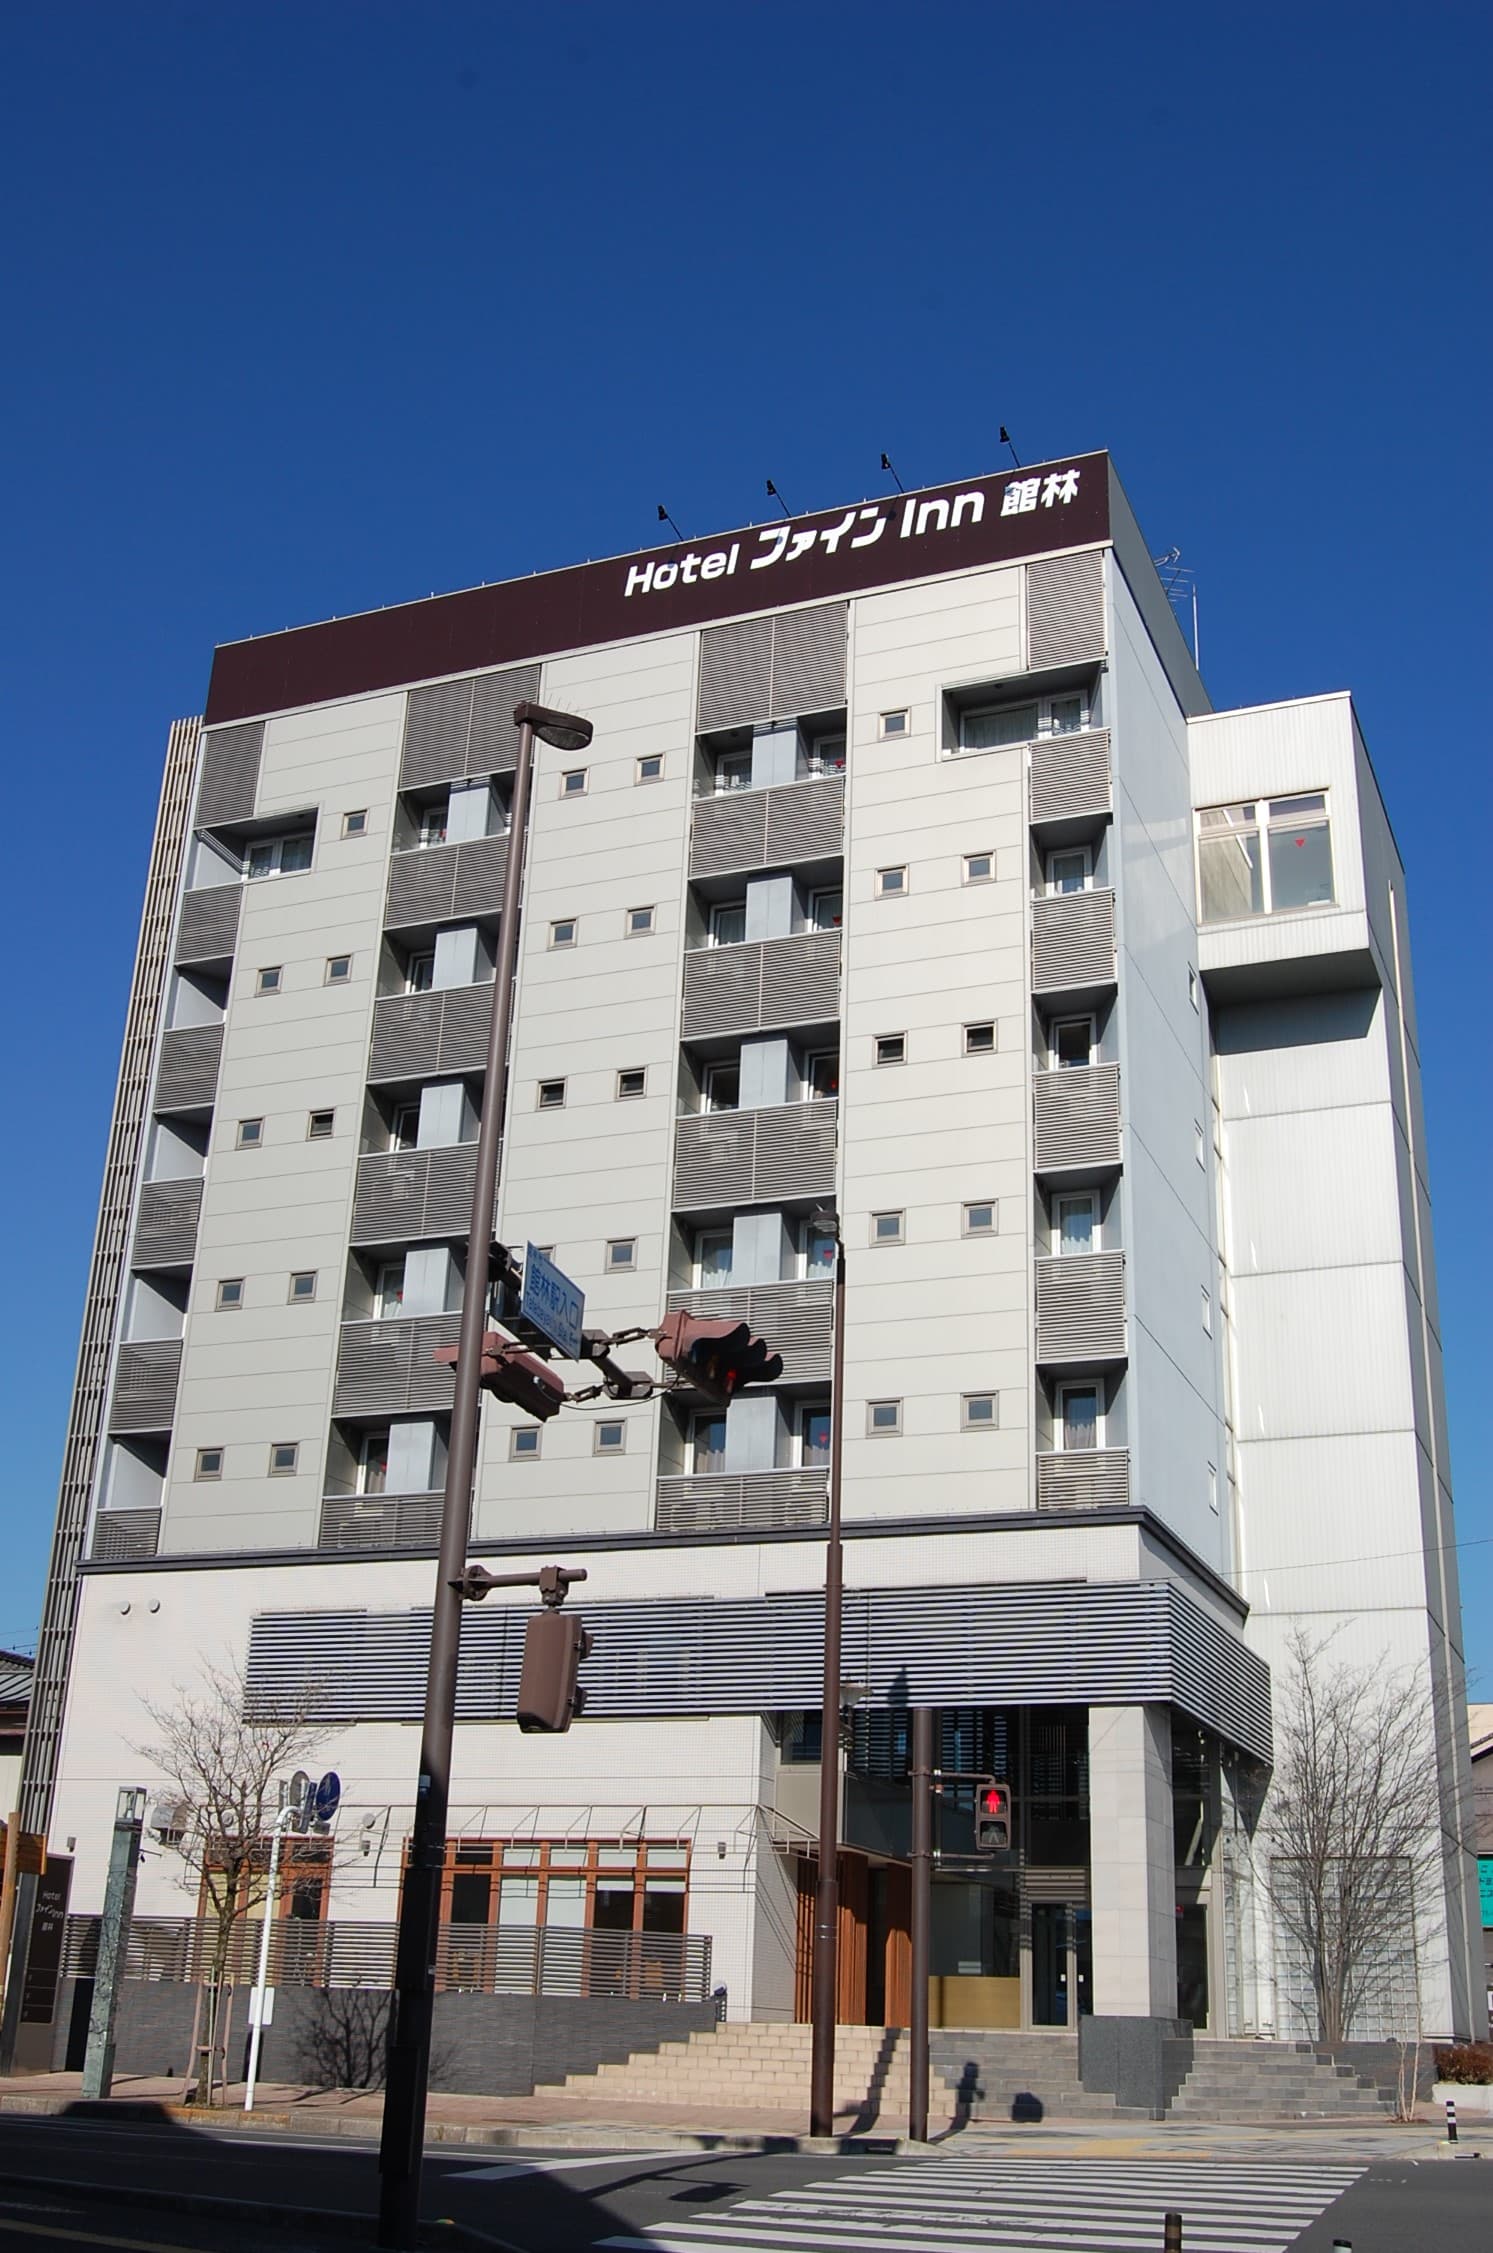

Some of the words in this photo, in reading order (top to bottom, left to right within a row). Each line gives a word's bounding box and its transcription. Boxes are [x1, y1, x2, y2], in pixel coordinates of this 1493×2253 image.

[624, 543, 740, 597] Hotel
[750, 507, 886, 571] ファイン
[900, 491, 984, 539] Inn
[1001, 469, 1081, 517] 館林
